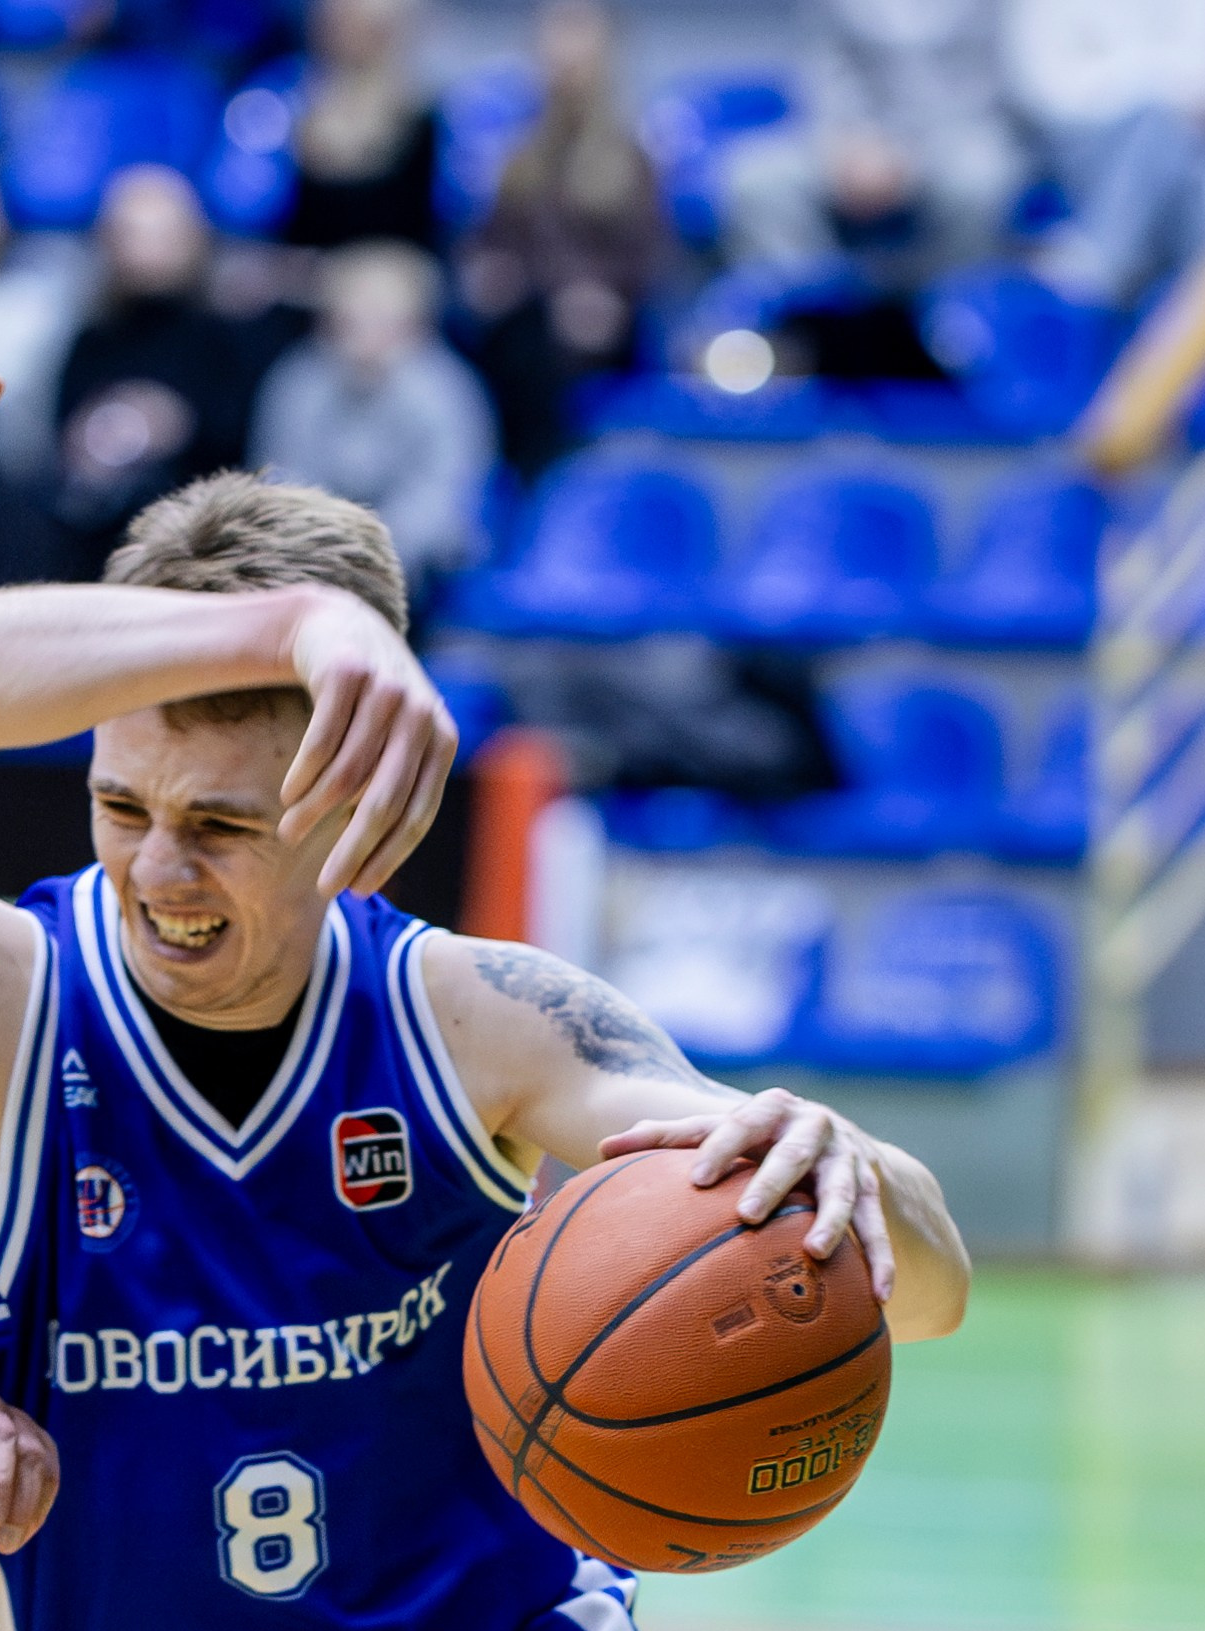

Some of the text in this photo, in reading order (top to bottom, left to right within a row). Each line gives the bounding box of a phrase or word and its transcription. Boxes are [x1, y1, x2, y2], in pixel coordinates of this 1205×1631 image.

[344, 1144, 403, 1178] Win
[46, 1261, 453, 1394] ОВОСИБИРСК
[213, 1449, 330, 1600] 8
